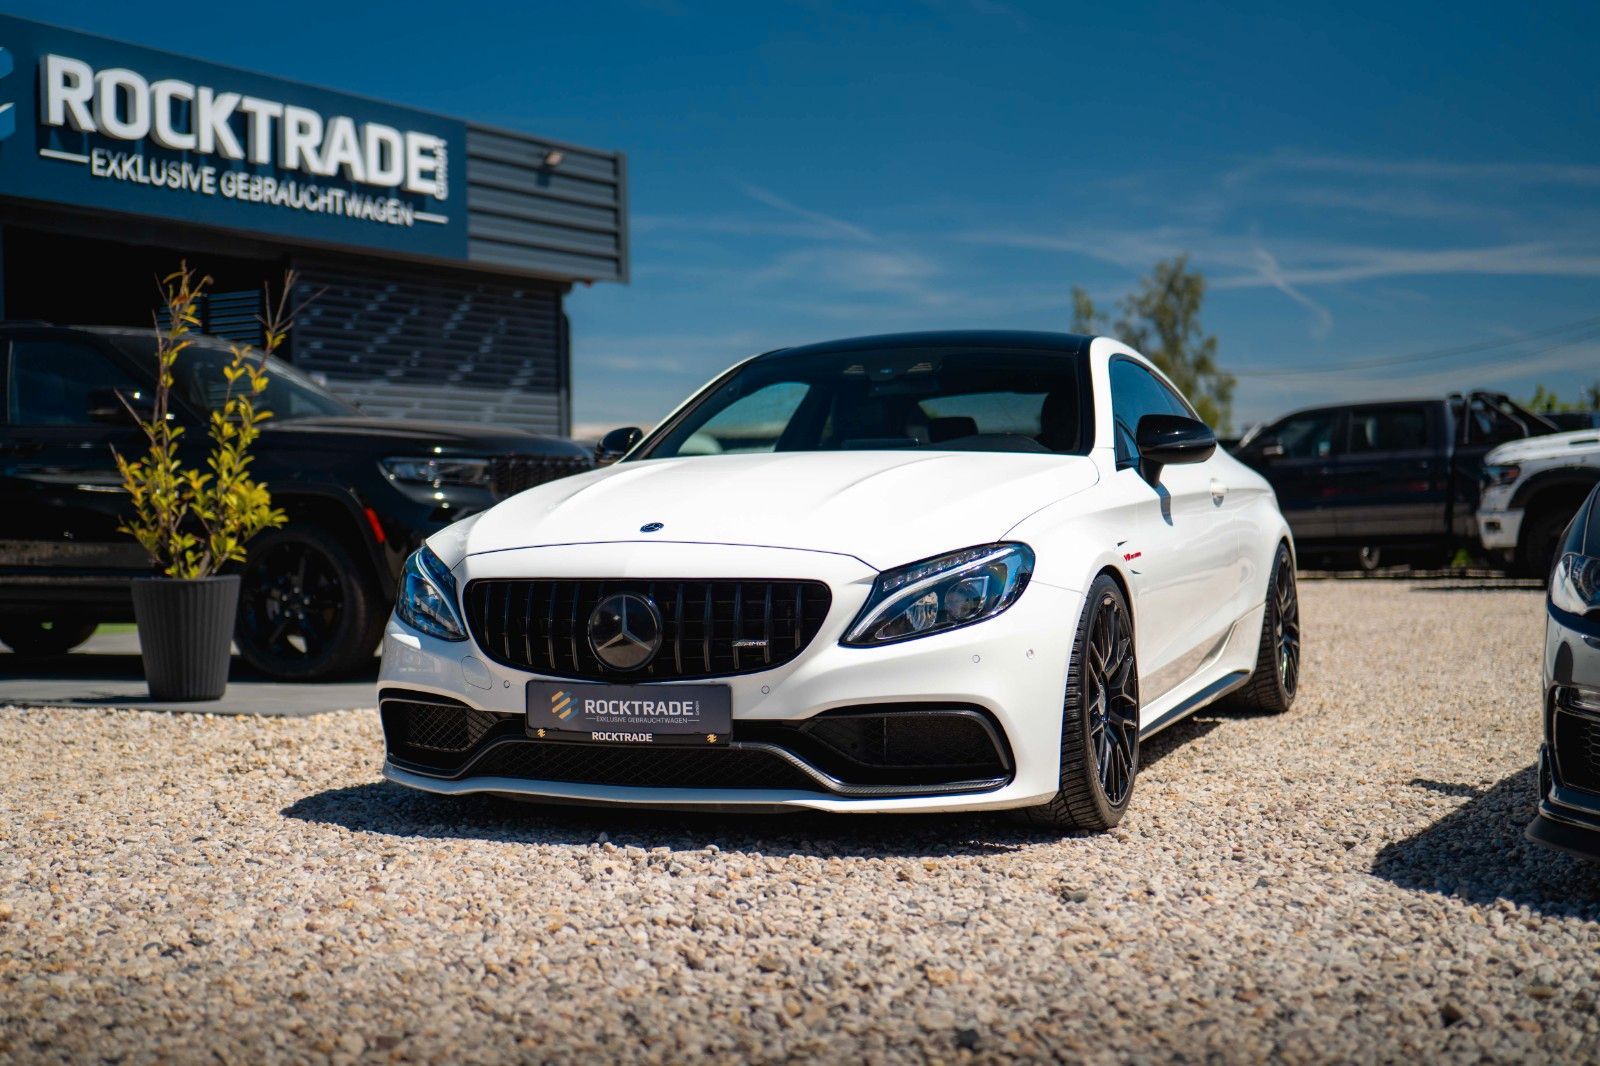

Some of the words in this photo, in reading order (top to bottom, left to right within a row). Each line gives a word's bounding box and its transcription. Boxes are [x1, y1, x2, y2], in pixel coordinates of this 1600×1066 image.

[40, 53, 440, 194] ROCKTRADE
[91, 148, 217, 194] EXKLUSIVE
[219, 170, 414, 226] GEBRAUCHTWAGEN
[585, 699, 693, 716] ROCKTRADE
[592, 732, 653, 742] ROCKTRADE
